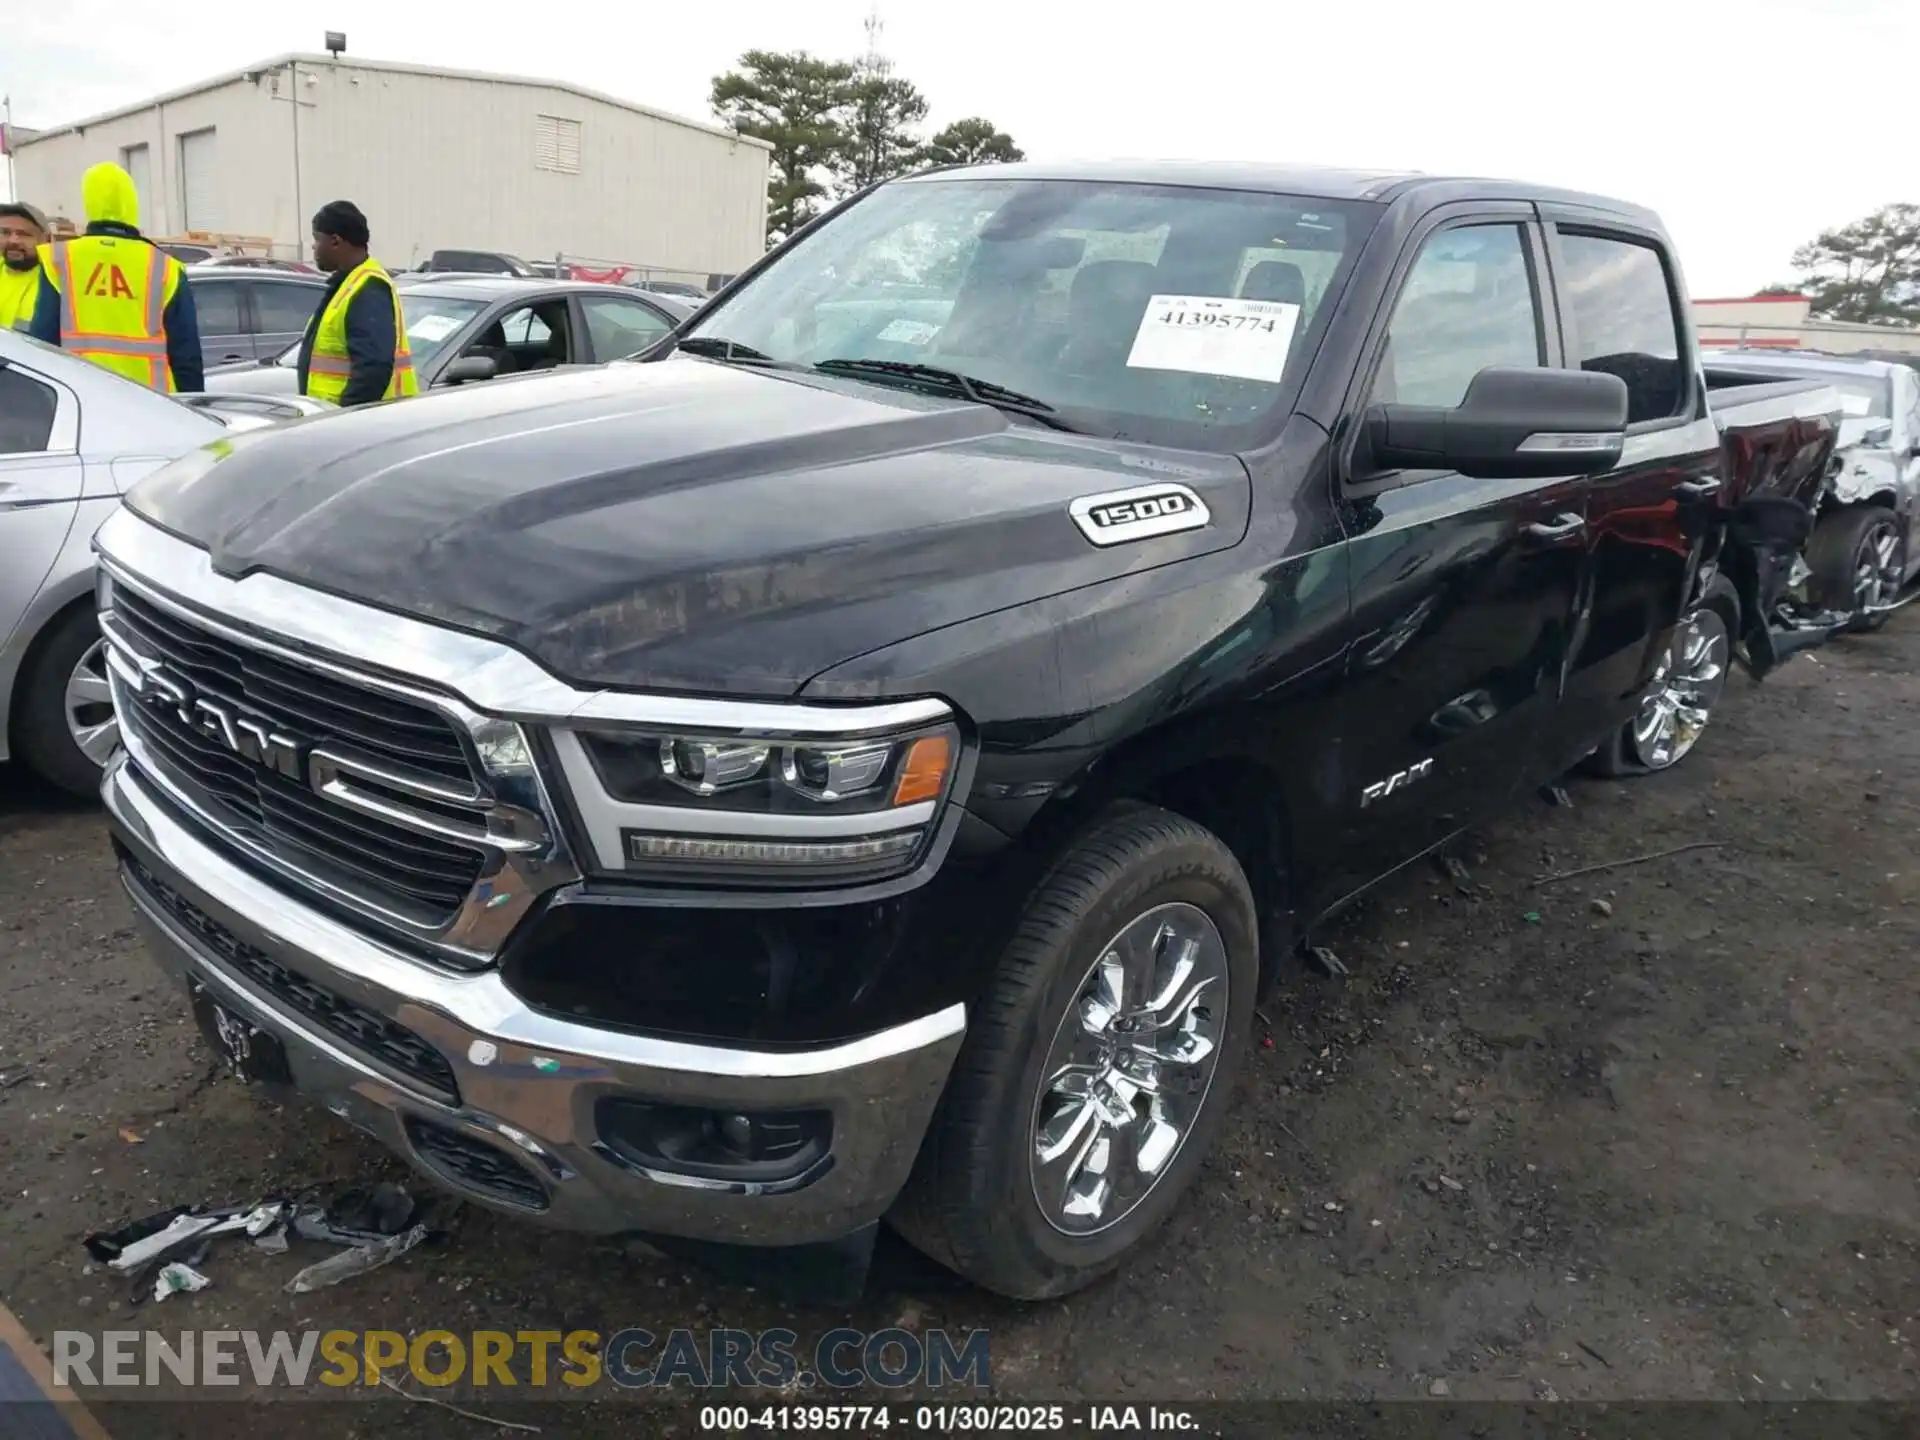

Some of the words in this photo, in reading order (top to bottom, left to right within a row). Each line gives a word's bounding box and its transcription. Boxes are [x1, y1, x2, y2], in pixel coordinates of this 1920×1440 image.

[1158, 311, 1276, 333] 41395774
[1093, 495, 1186, 526] 1500
[1360, 757, 1434, 808] RAM
